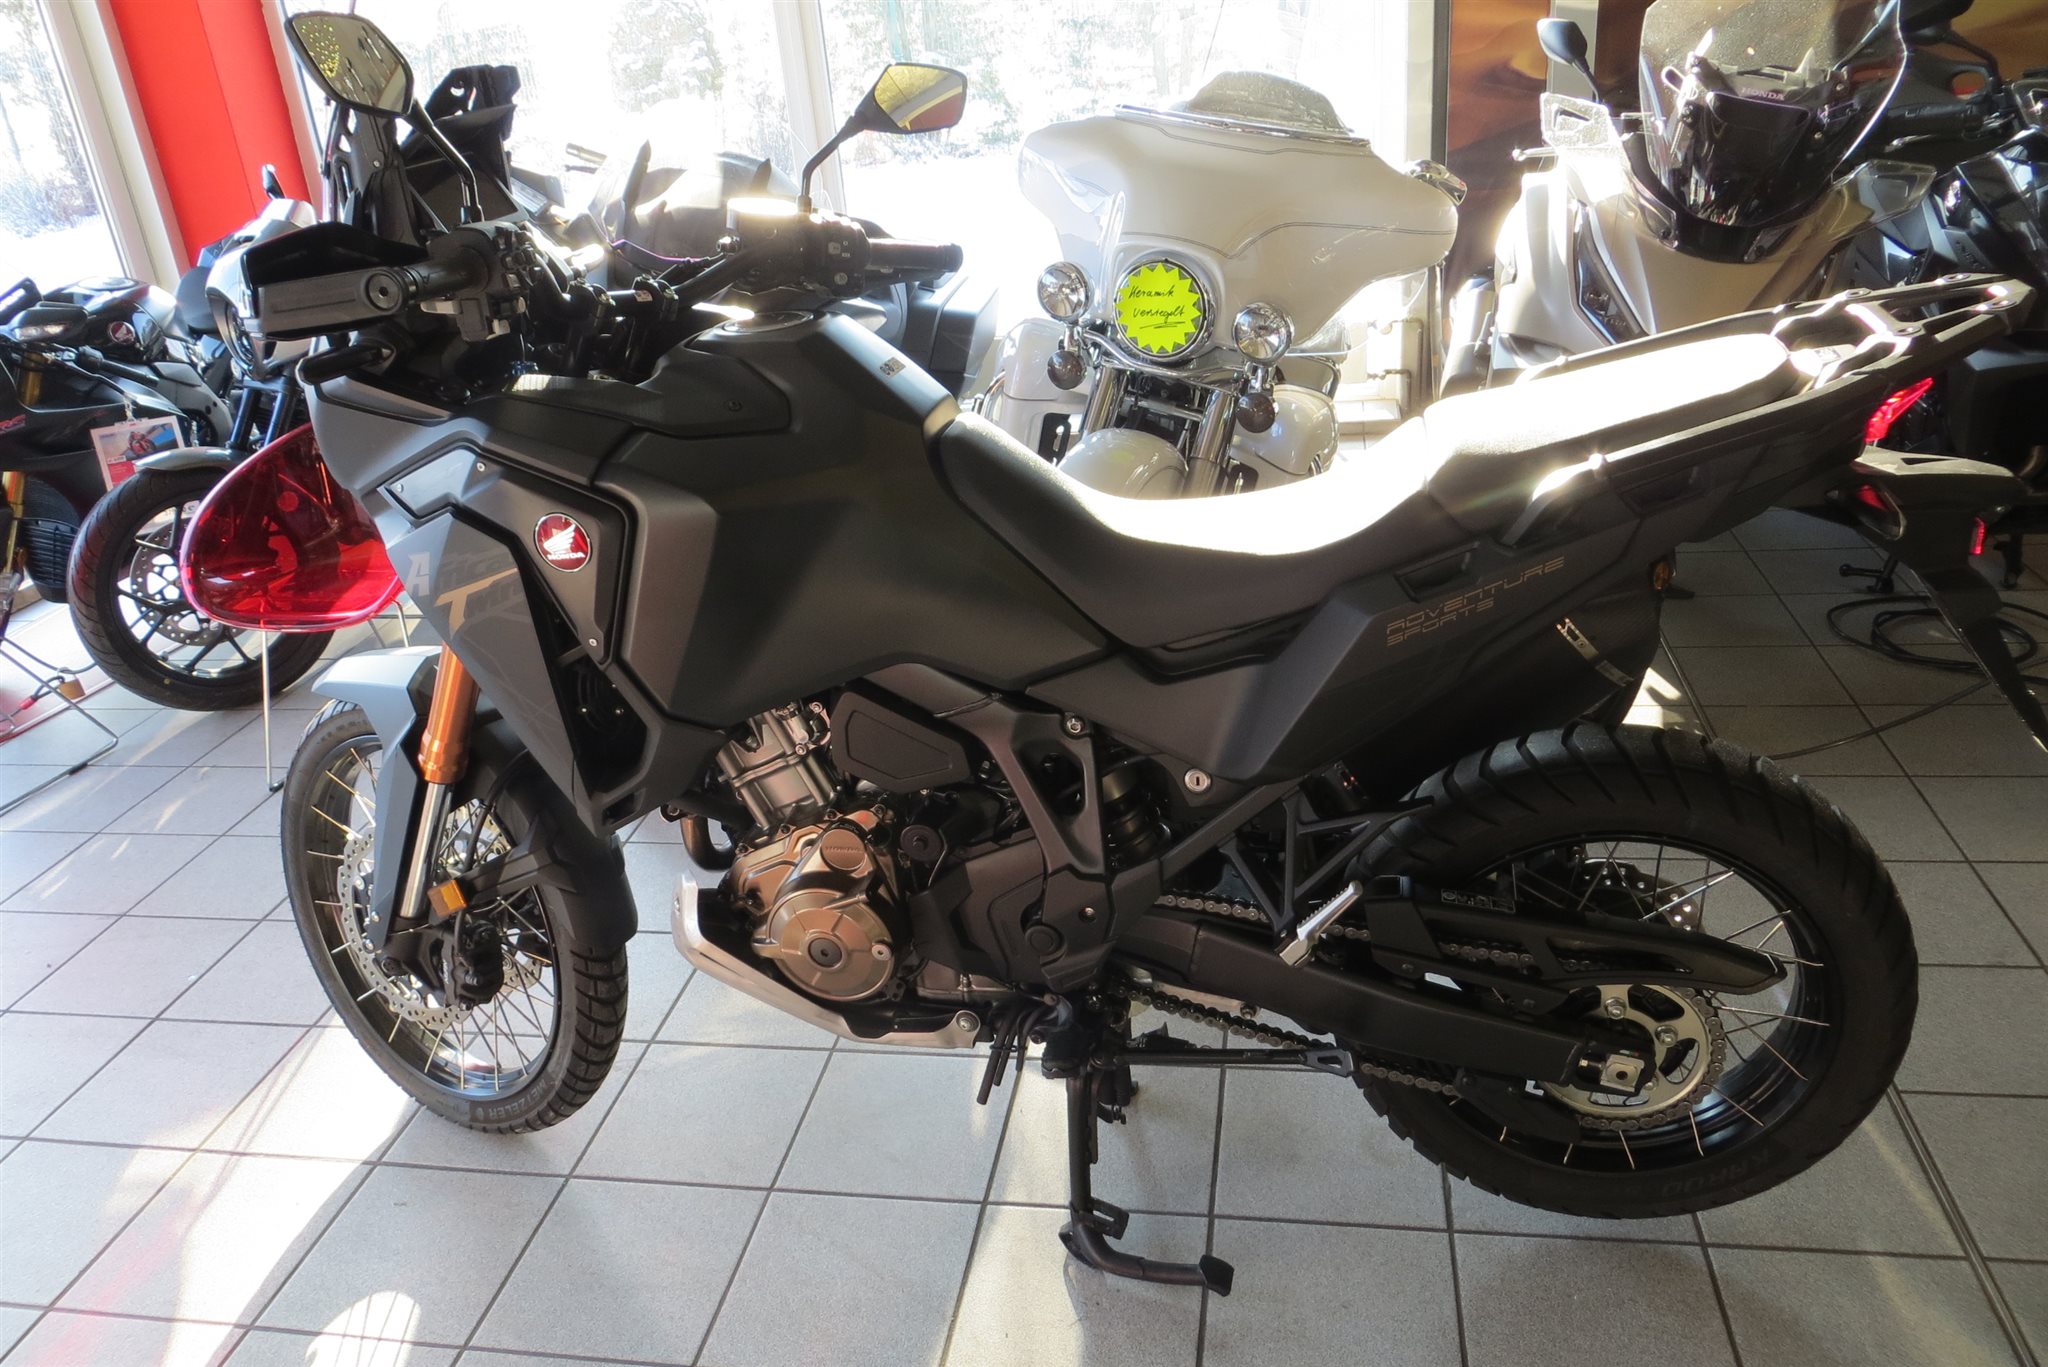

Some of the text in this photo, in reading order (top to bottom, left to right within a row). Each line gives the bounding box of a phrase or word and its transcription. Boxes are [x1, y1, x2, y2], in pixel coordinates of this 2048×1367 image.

[1739, 87, 1785, 101] HONDA
[1128, 284, 1175, 299] Keramik
[547, 552, 585, 560] HONDA
[1386, 556, 1565, 634] ADVENTURE
[1386, 598, 1495, 647] SPORTS
[488, 1079, 548, 1119] METZELER
